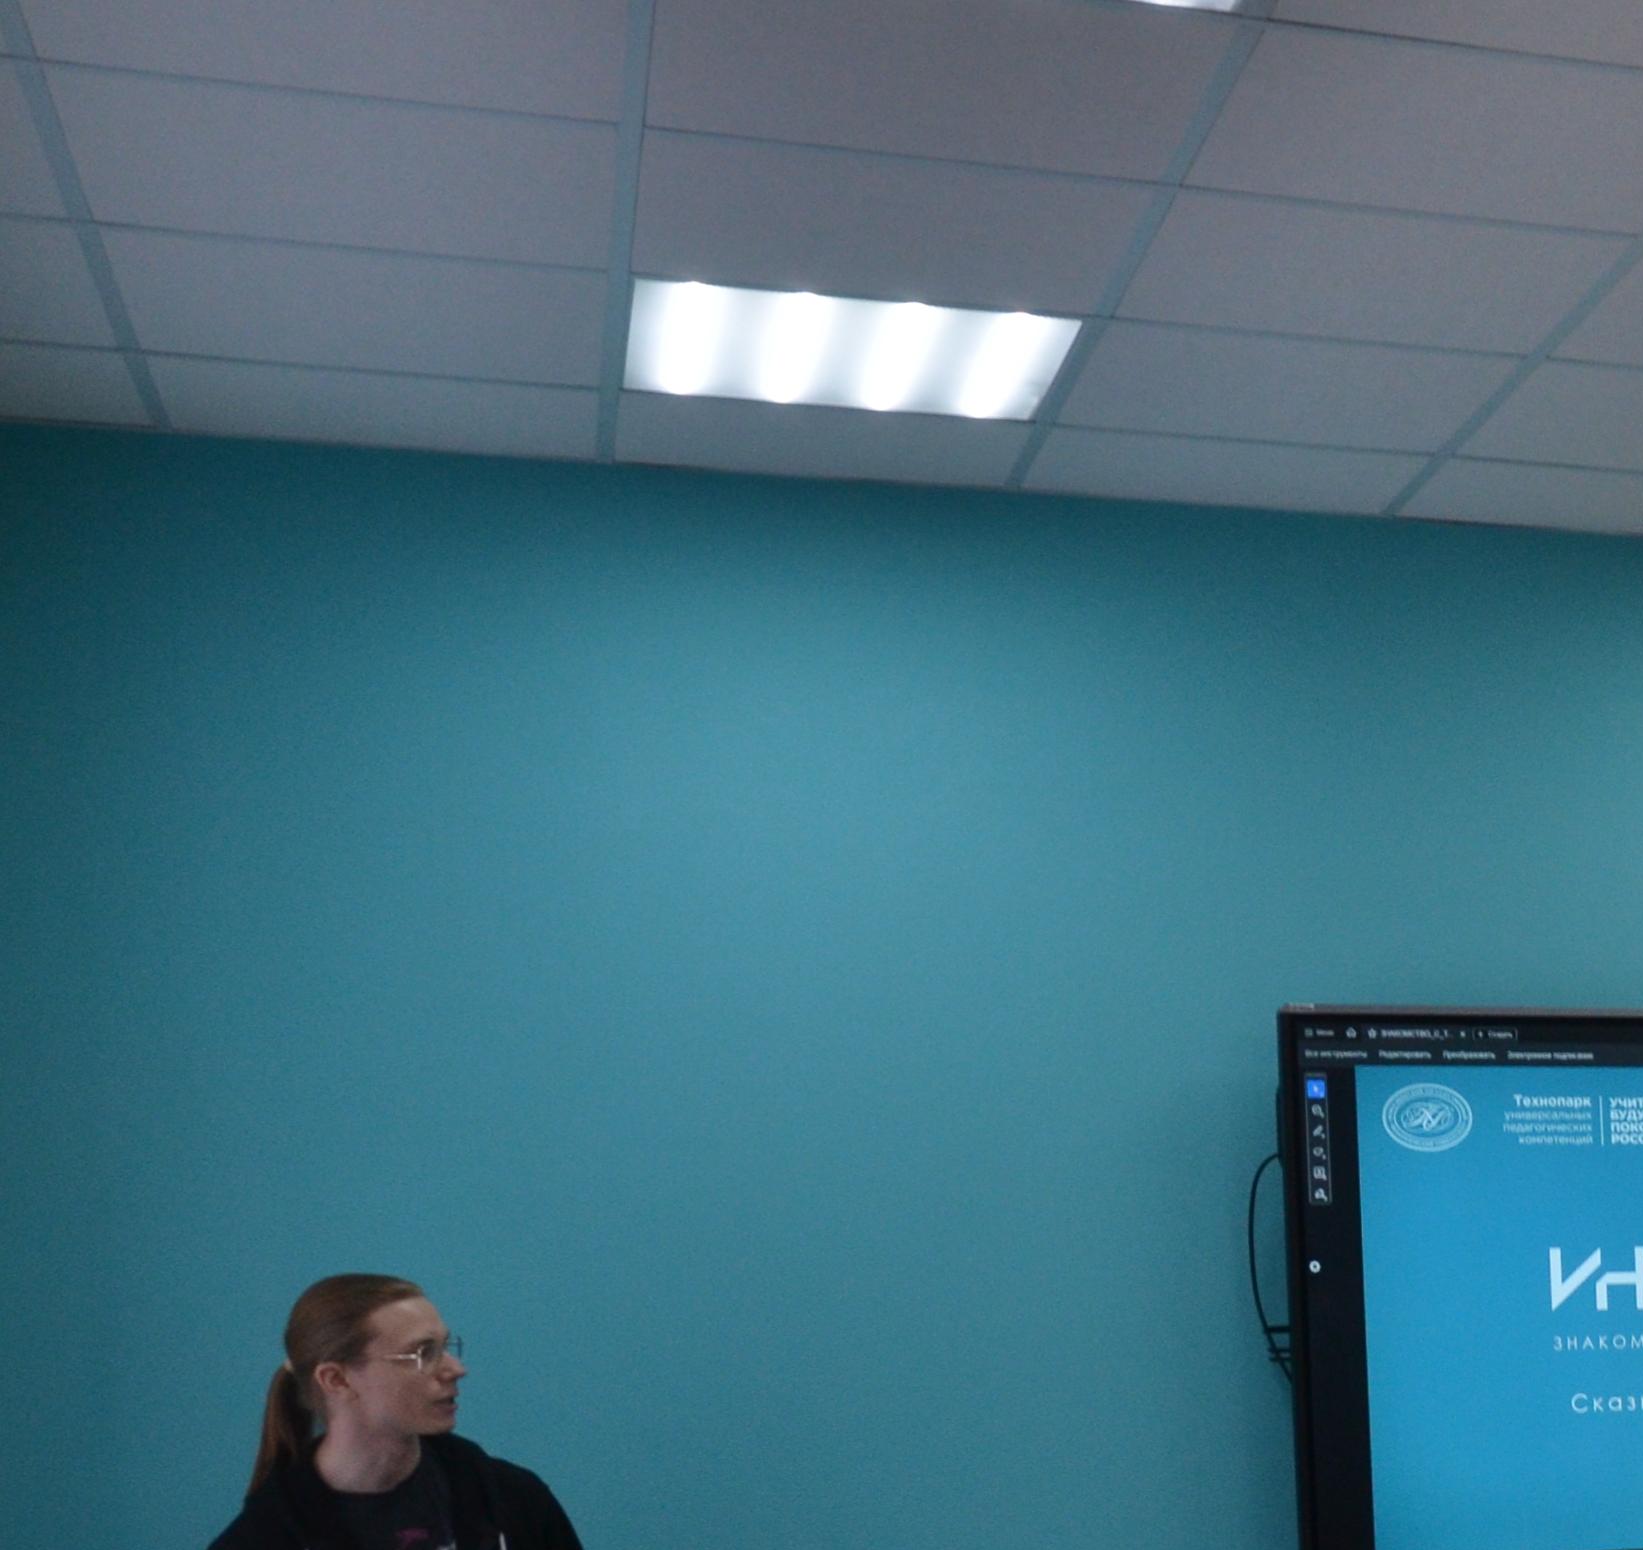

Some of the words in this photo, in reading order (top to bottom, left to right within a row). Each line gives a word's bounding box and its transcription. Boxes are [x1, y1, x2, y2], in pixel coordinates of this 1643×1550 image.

[1513, 1093, 1592, 1109] Технопарк
[1503, 1110, 1592, 1121] универсальных
[1503, 1122, 1593, 1134] педагогических
[1518, 1133, 1594, 1146] компетенций
